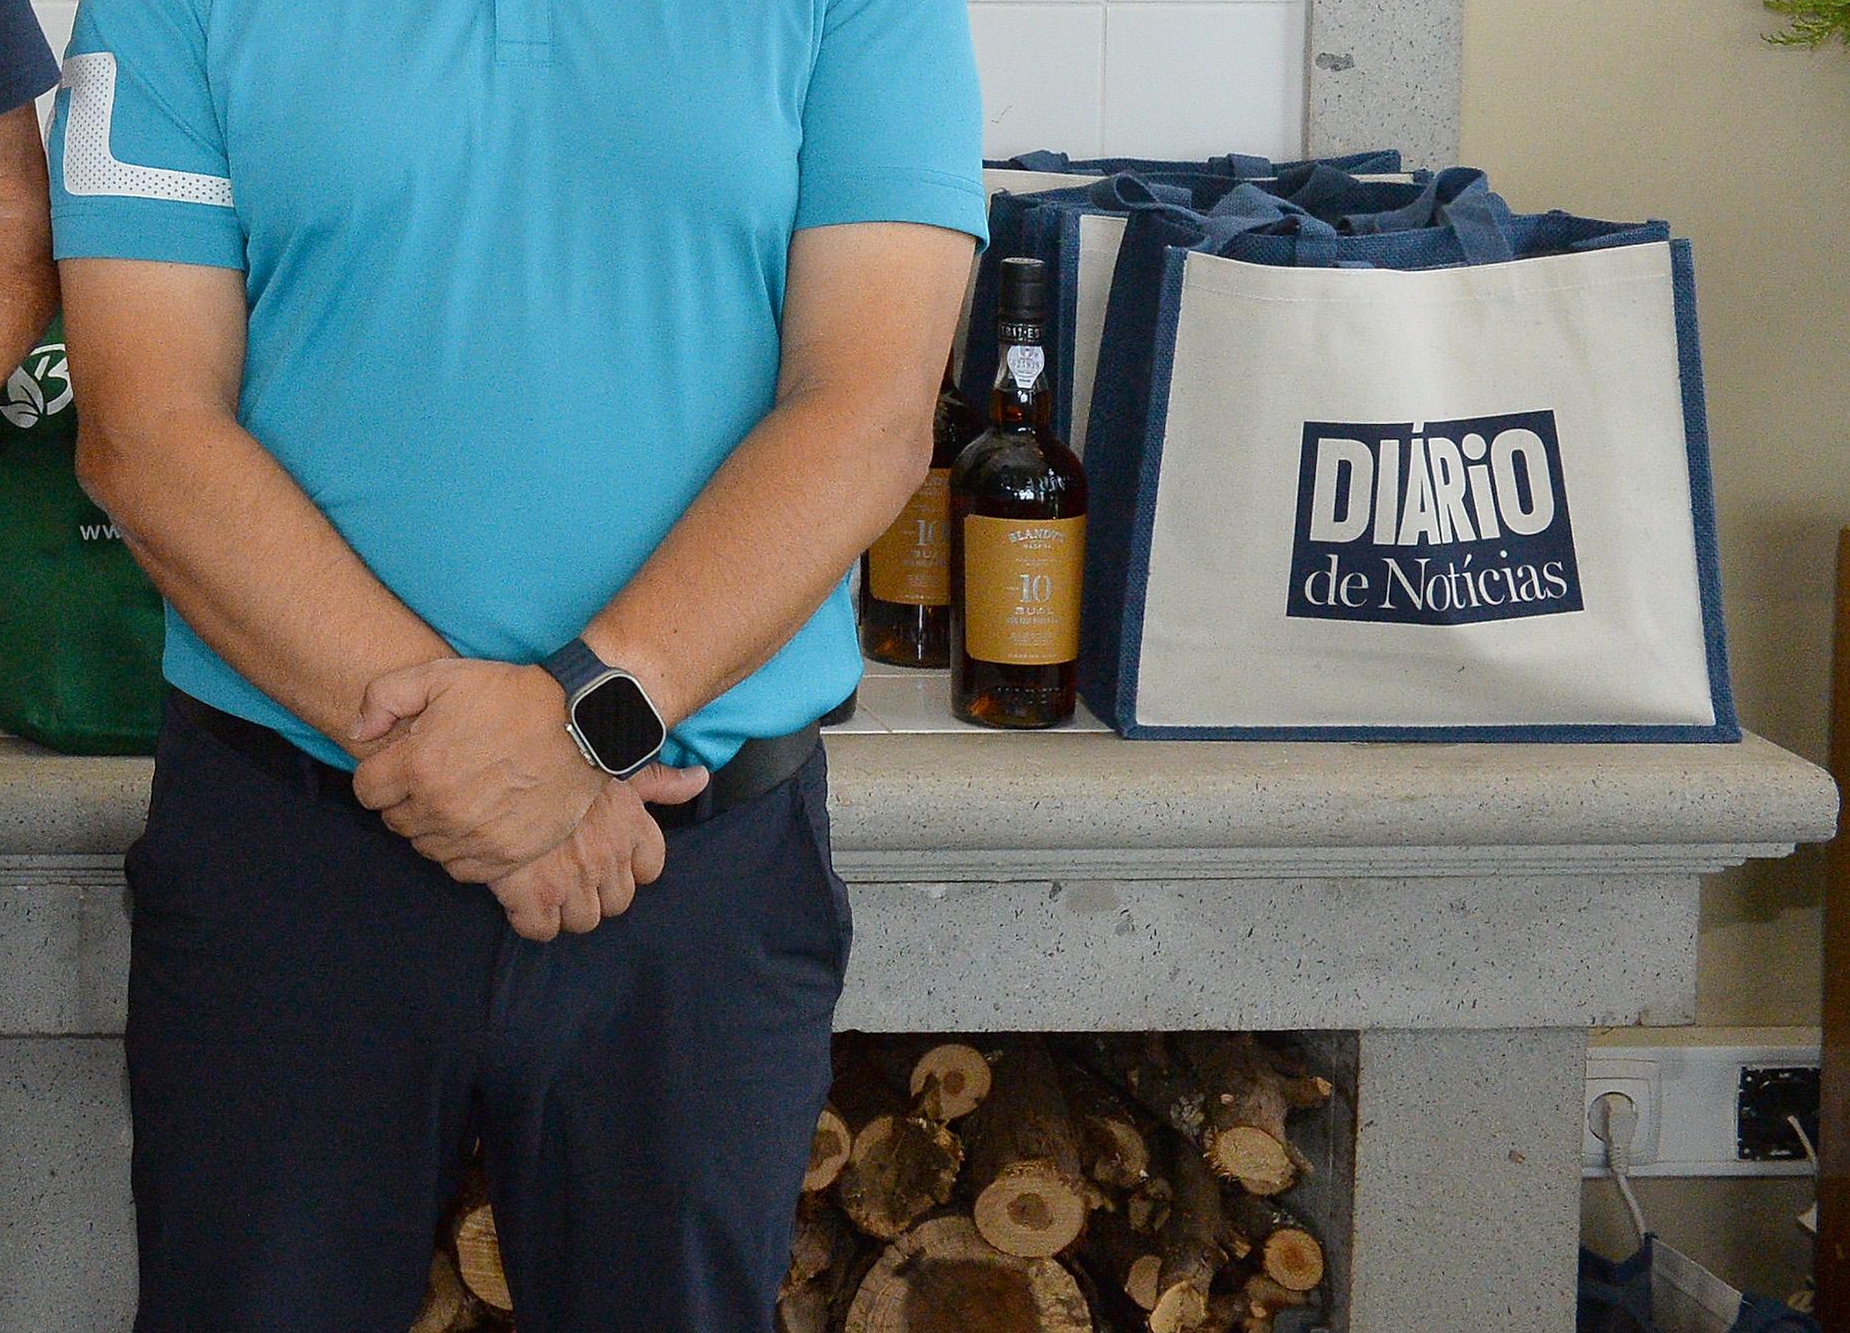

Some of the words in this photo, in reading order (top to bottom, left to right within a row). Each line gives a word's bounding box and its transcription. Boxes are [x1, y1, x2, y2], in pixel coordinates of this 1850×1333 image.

[1020, 573, 1053, 603] 10
[1304, 554, 1369, 608] de
[1378, 549, 1568, 612] Notícias
